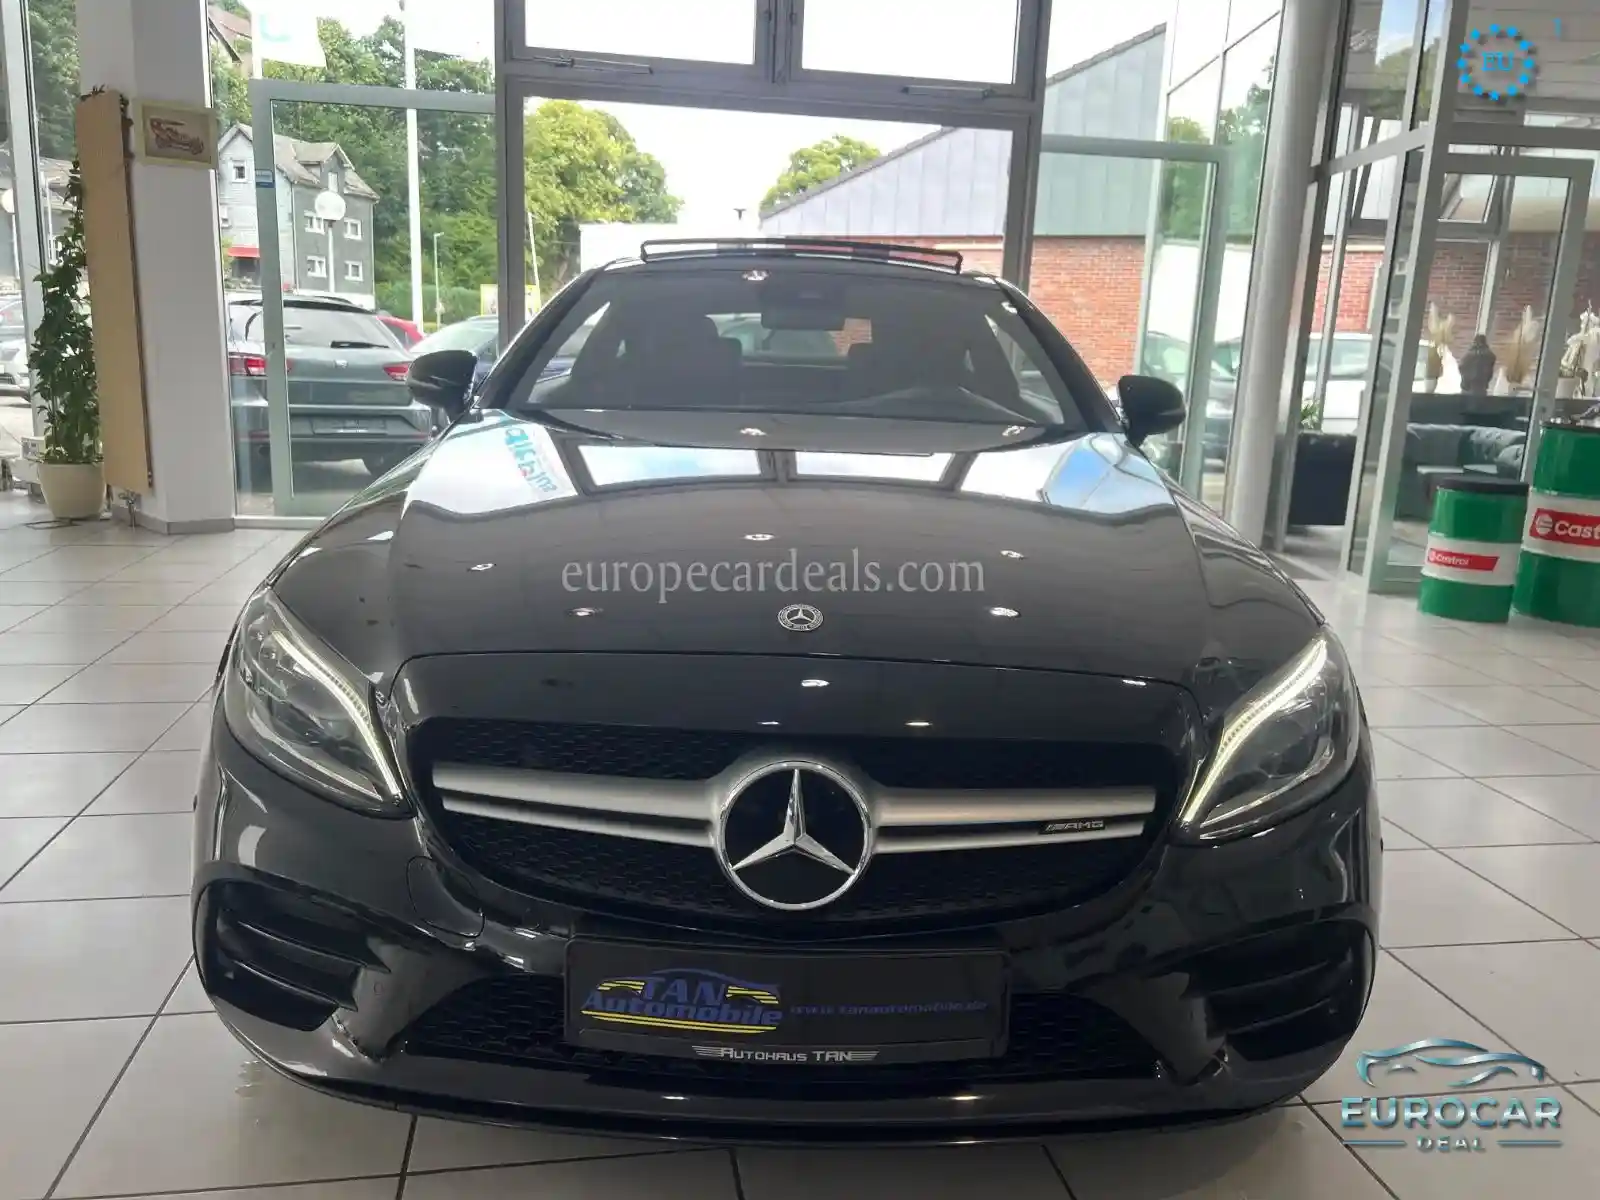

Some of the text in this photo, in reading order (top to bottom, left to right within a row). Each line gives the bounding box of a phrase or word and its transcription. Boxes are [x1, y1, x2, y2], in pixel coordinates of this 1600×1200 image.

[640, 976, 726, 1007] TAN
[580, 989, 784, 1027] Automobile
[720, 1047, 852, 1062] AUTOHAUS TAN
